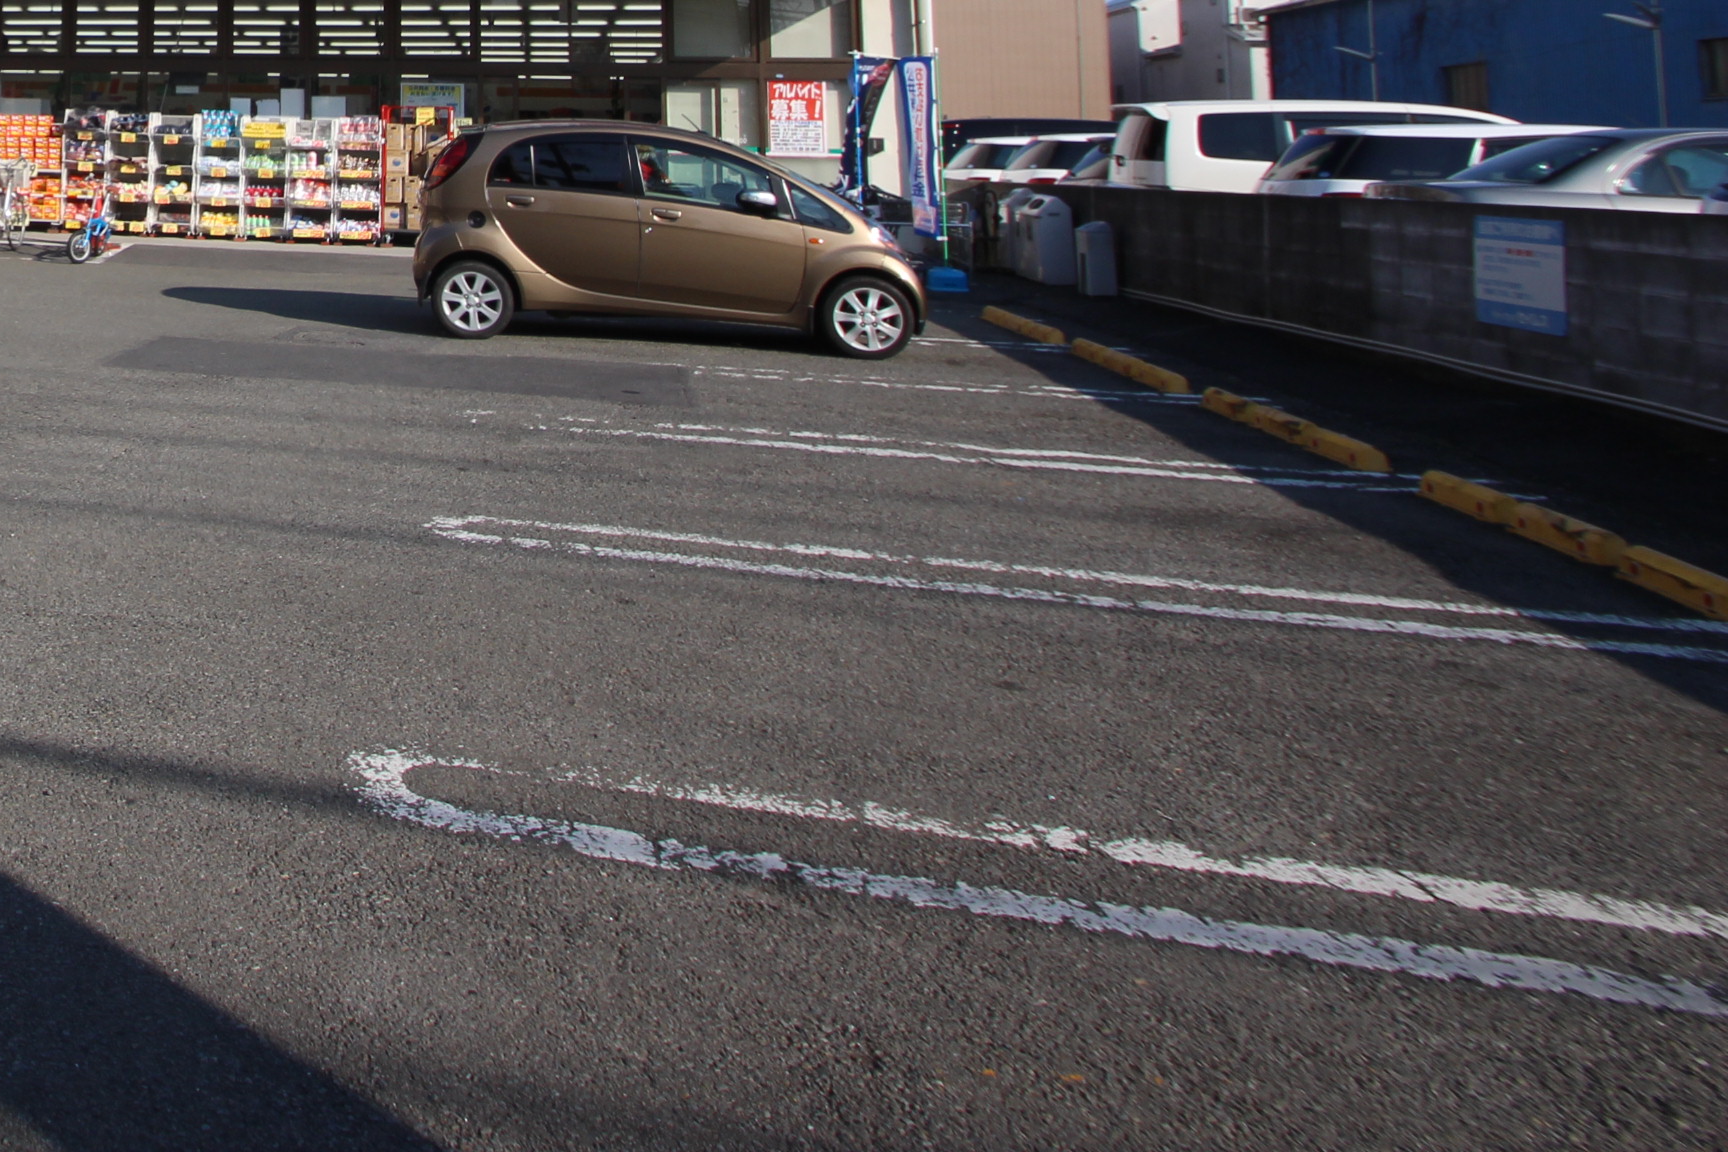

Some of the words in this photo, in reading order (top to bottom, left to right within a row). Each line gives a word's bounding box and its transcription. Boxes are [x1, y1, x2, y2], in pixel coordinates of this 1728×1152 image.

[773, 82, 822, 99] アルバイト
